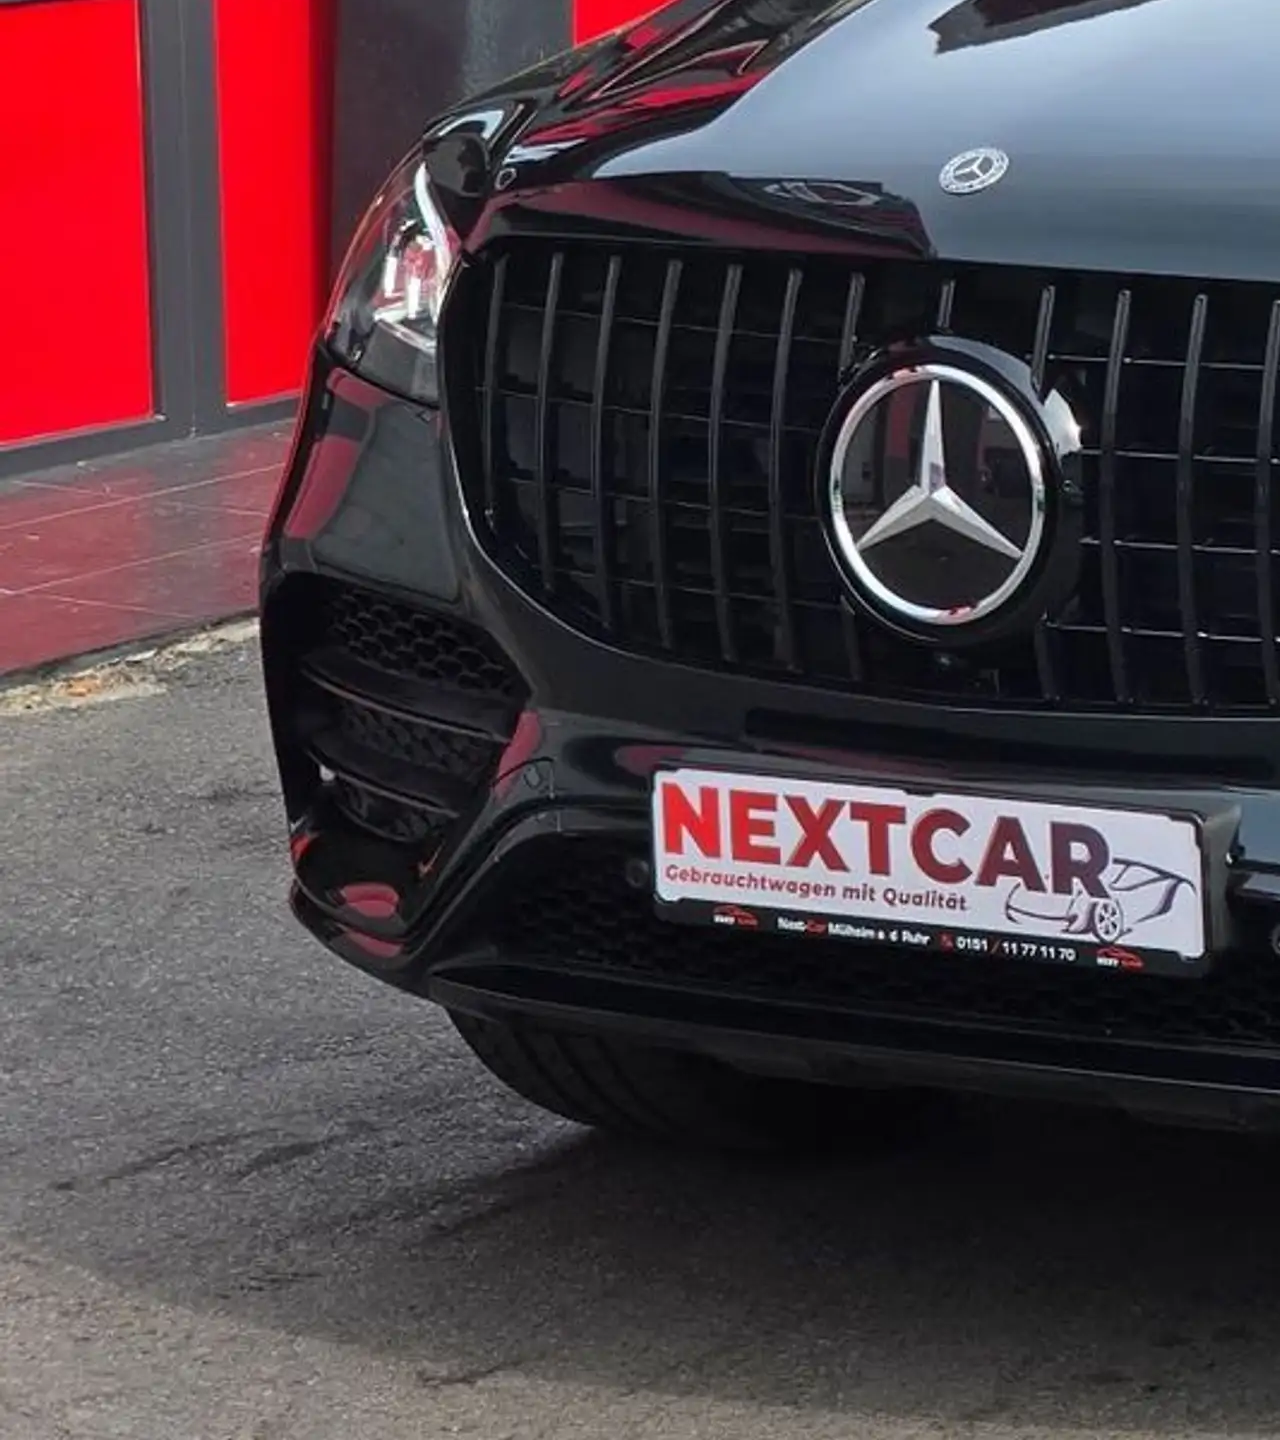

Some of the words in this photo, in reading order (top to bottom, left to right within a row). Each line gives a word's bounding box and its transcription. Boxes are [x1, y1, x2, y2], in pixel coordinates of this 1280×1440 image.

[661, 781, 1112, 900] NEXTCAR
[665, 863, 836, 899] Gebrauchtwagen
[842, 882, 876, 902] mit
[883, 887, 967, 912] Qualität
[1002, 941, 1018, 955] 11
[1020, 944, 1038, 958] 77
[1040, 947, 1056, 960] 11
